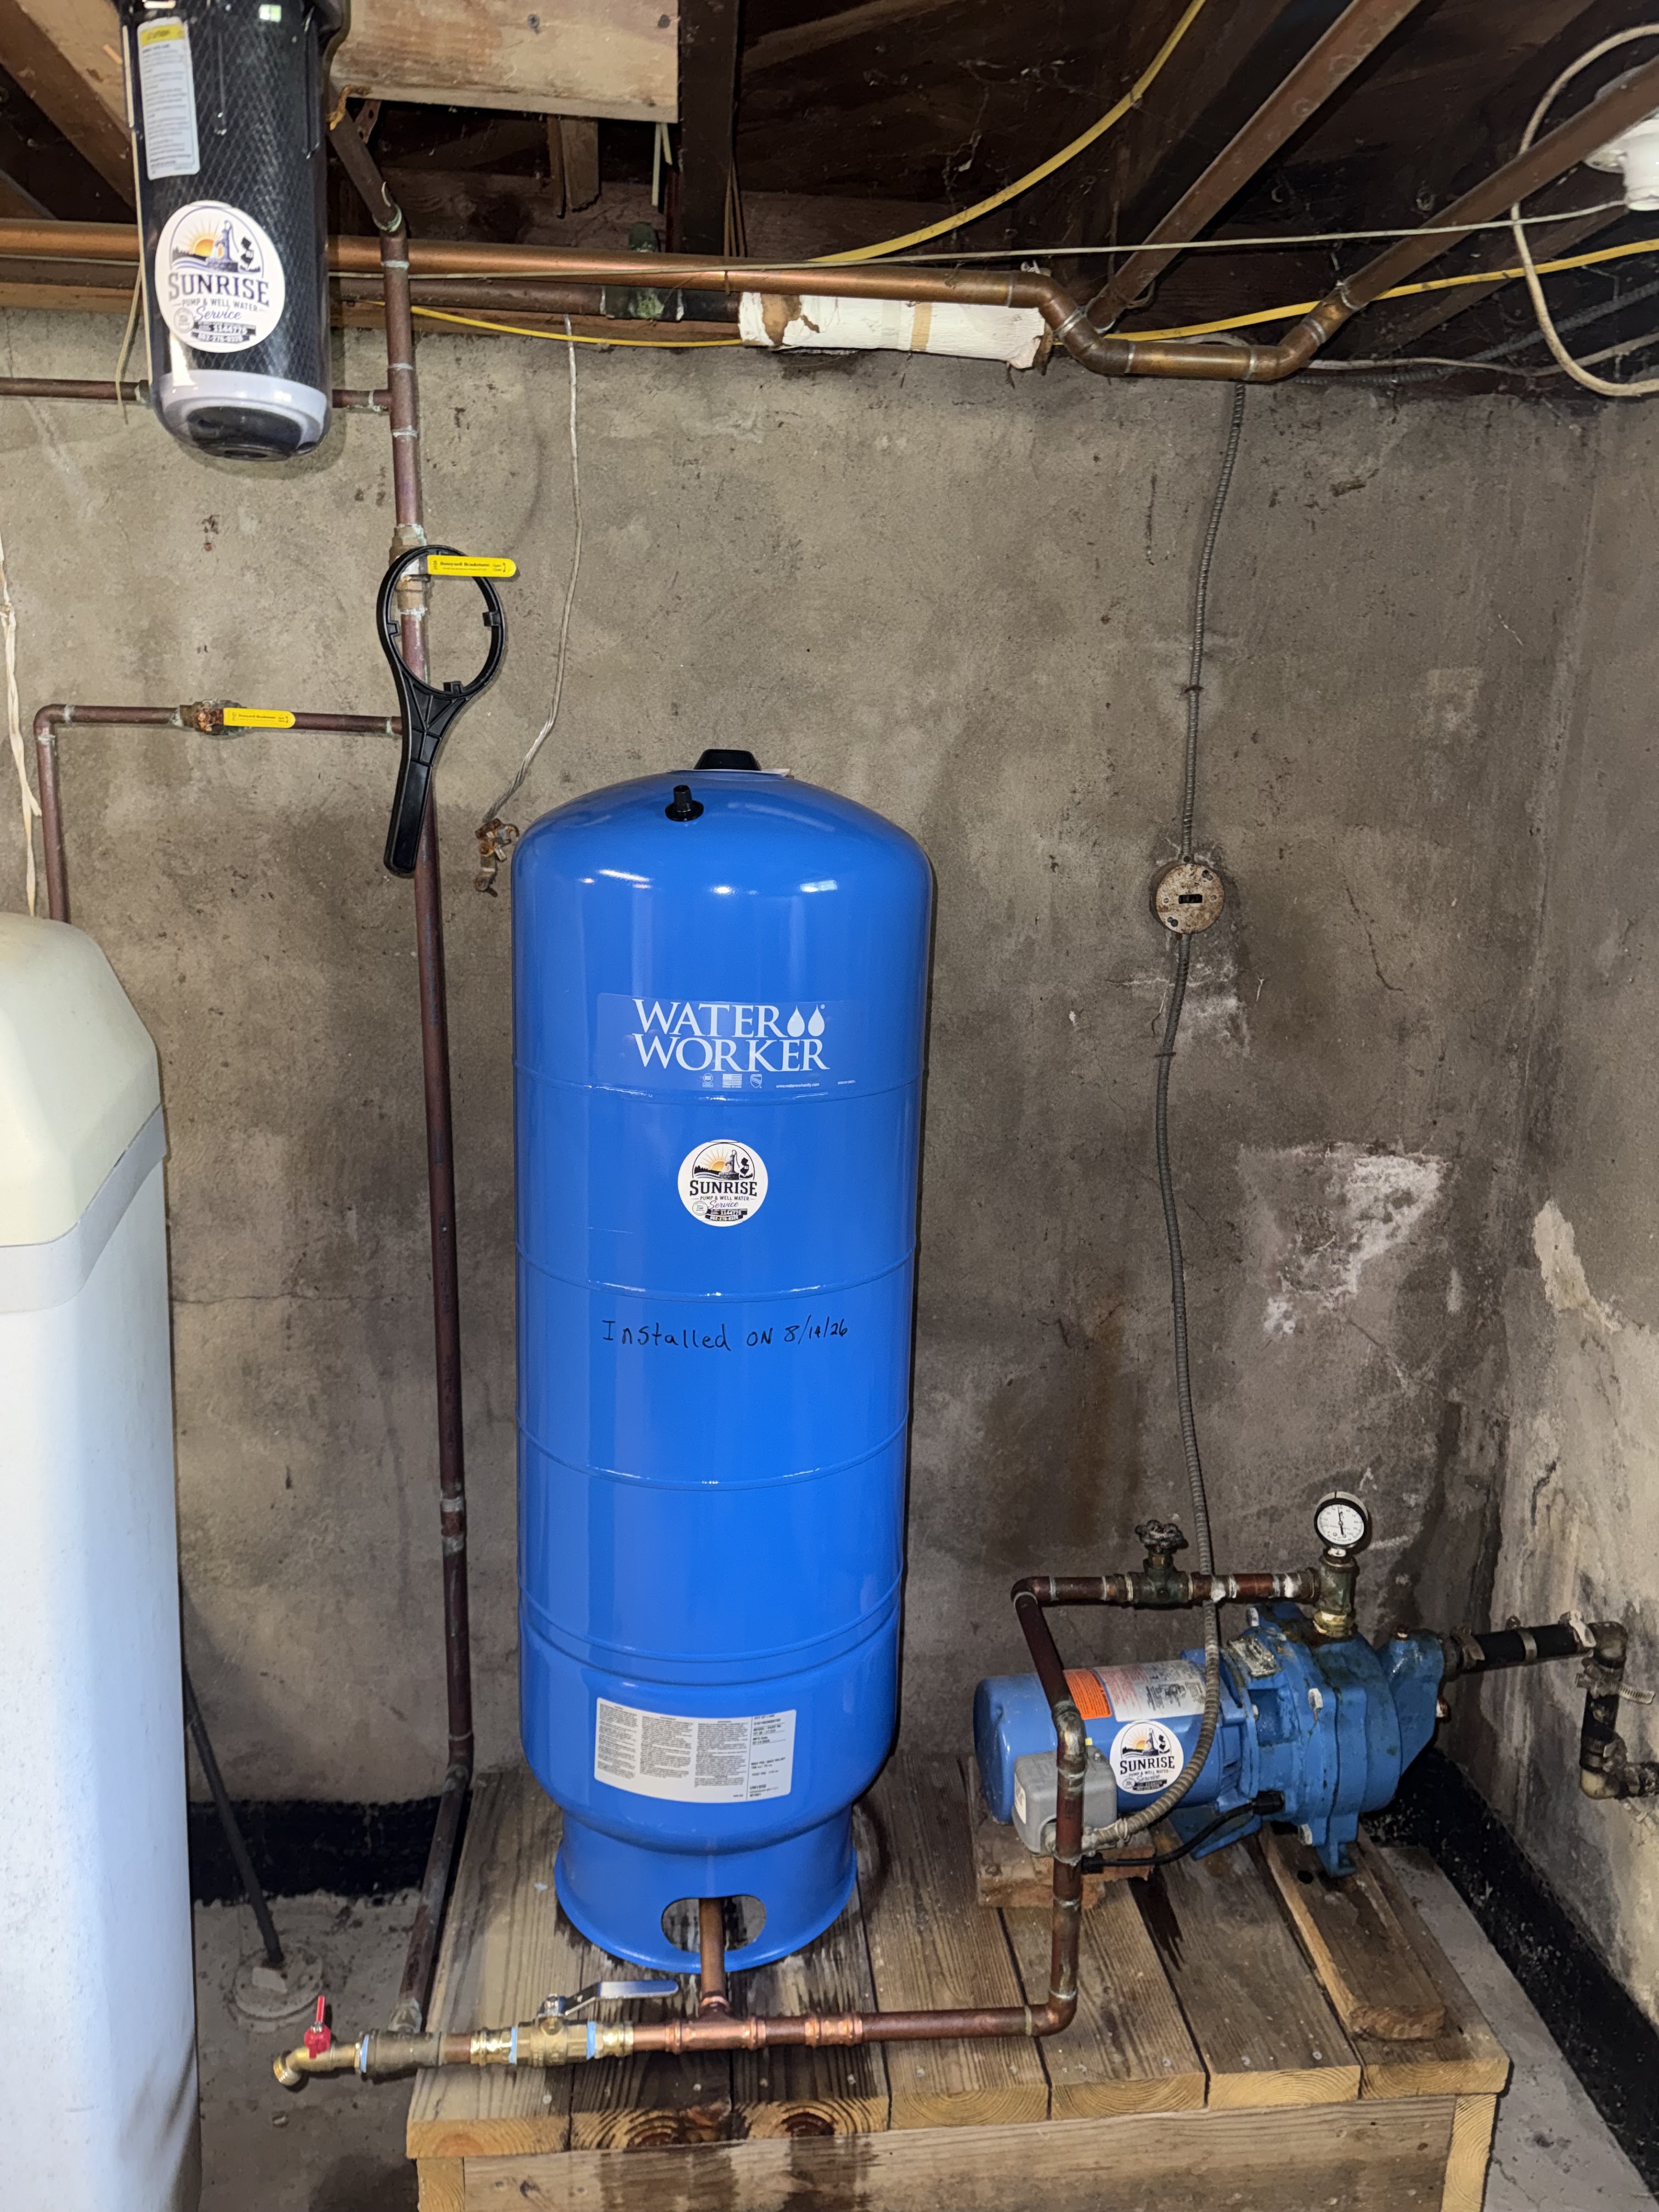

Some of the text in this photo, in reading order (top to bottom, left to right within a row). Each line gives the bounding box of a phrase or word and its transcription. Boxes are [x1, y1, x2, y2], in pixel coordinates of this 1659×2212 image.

[168, 272, 269, 307] SUNRISE
[182, 298, 201, 307] PUMP
[211, 298, 230, 308] WELL
[233, 300, 258, 312] WATER
[194, 305, 242, 323] Service
[632, 998, 788, 1038] WATER
[632, 1033, 831, 1072] WORKER
[690, 1180, 757, 1197] SUNRISE
[707, 1200, 739, 1209] Service
[602, 1314, 849, 1352] Installed ON 8/14/26
[1120, 1756, 1175, 1775] SUNRISE
